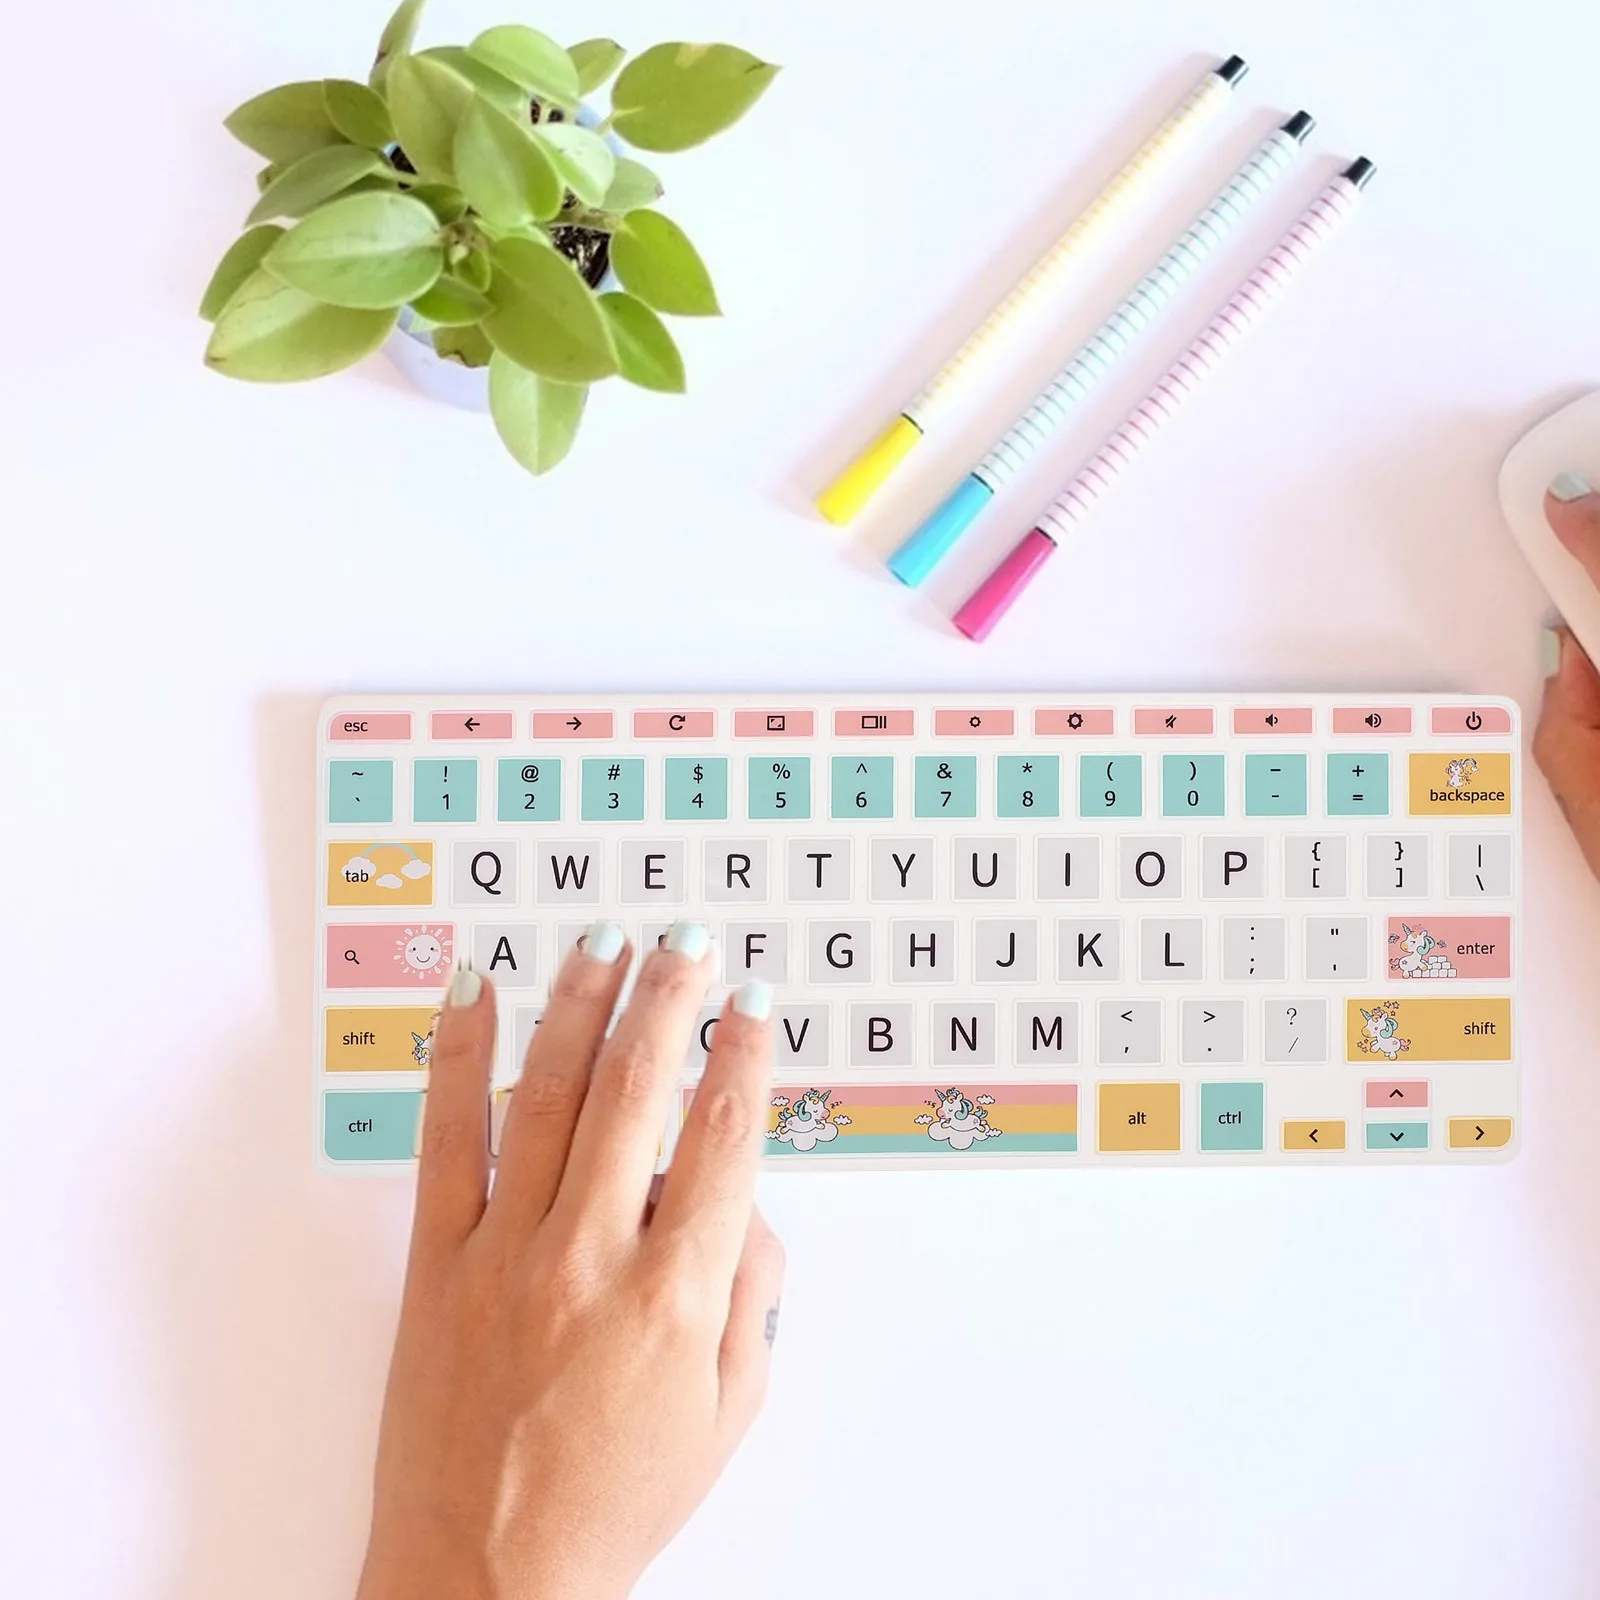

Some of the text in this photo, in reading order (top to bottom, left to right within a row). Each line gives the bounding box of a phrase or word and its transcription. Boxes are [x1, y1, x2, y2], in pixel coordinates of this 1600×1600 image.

[343, 721, 368, 732] esc
[521, 764, 539, 783] @
[607, 764, 621, 781] #
[693, 763, 704, 784] $
[772, 763, 791, 780] %
[856, 762, 868, 774] ^
[936, 763, 953, 779] &
[1351, 764, 1365, 777] +
[524, 793, 536, 810] 2
[608, 792, 619, 809] 3
[691, 792, 704, 809] 4
[775, 791, 787, 809] 5
[855, 791, 868, 808] 6
[940, 791, 952, 807] 7
[1022, 790, 1034, 808] 8
[1104, 790, 1116, 807] 9
[1187, 790, 1199, 807] 0
[1430, 788, 1505, 804] backspace
[1311, 841, 1321, 862] {
[1394, 841, 1404, 861] }
[345, 869, 369, 883] tab
[470, 851, 502, 895] Q
[550, 855, 590, 890] W
[644, 854, 666, 890] E
[726, 853, 751, 889] R
[806, 853, 833, 889] T
[891, 853, 916, 888] Y
[972, 852, 998, 888] U
[1064, 852, 1071, 887] I
[1135, 851, 1166, 887] O
[1224, 851, 1248, 886] P
[489, 936, 518, 971] A
[745, 933, 767, 969] F
[826, 932, 853, 969] G
[909, 932, 936, 968] H
[995, 932, 1015, 968] J
[1077, 932, 1104, 968] K
[1164, 932, 1185, 967] L
[1456, 942, 1496, 955] enter
[1120, 1010, 1133, 1022] <
[1203, 1010, 1216, 1023] >
[1286, 1007, 1297, 1025] ?
[782, 1017, 810, 1053] V
[868, 1017, 894, 1052] B
[951, 1016, 977, 1052] N
[1032, 1016, 1063, 1051] M
[1464, 1021, 1496, 1035] shift
[342, 1031, 376, 1045] shift
[1288, 1037, 1299, 1053] /
[348, 1118, 372, 1133] ctrl
[1128, 1111, 1147, 1125] alt
[1218, 1110, 1242, 1125] ctrl
